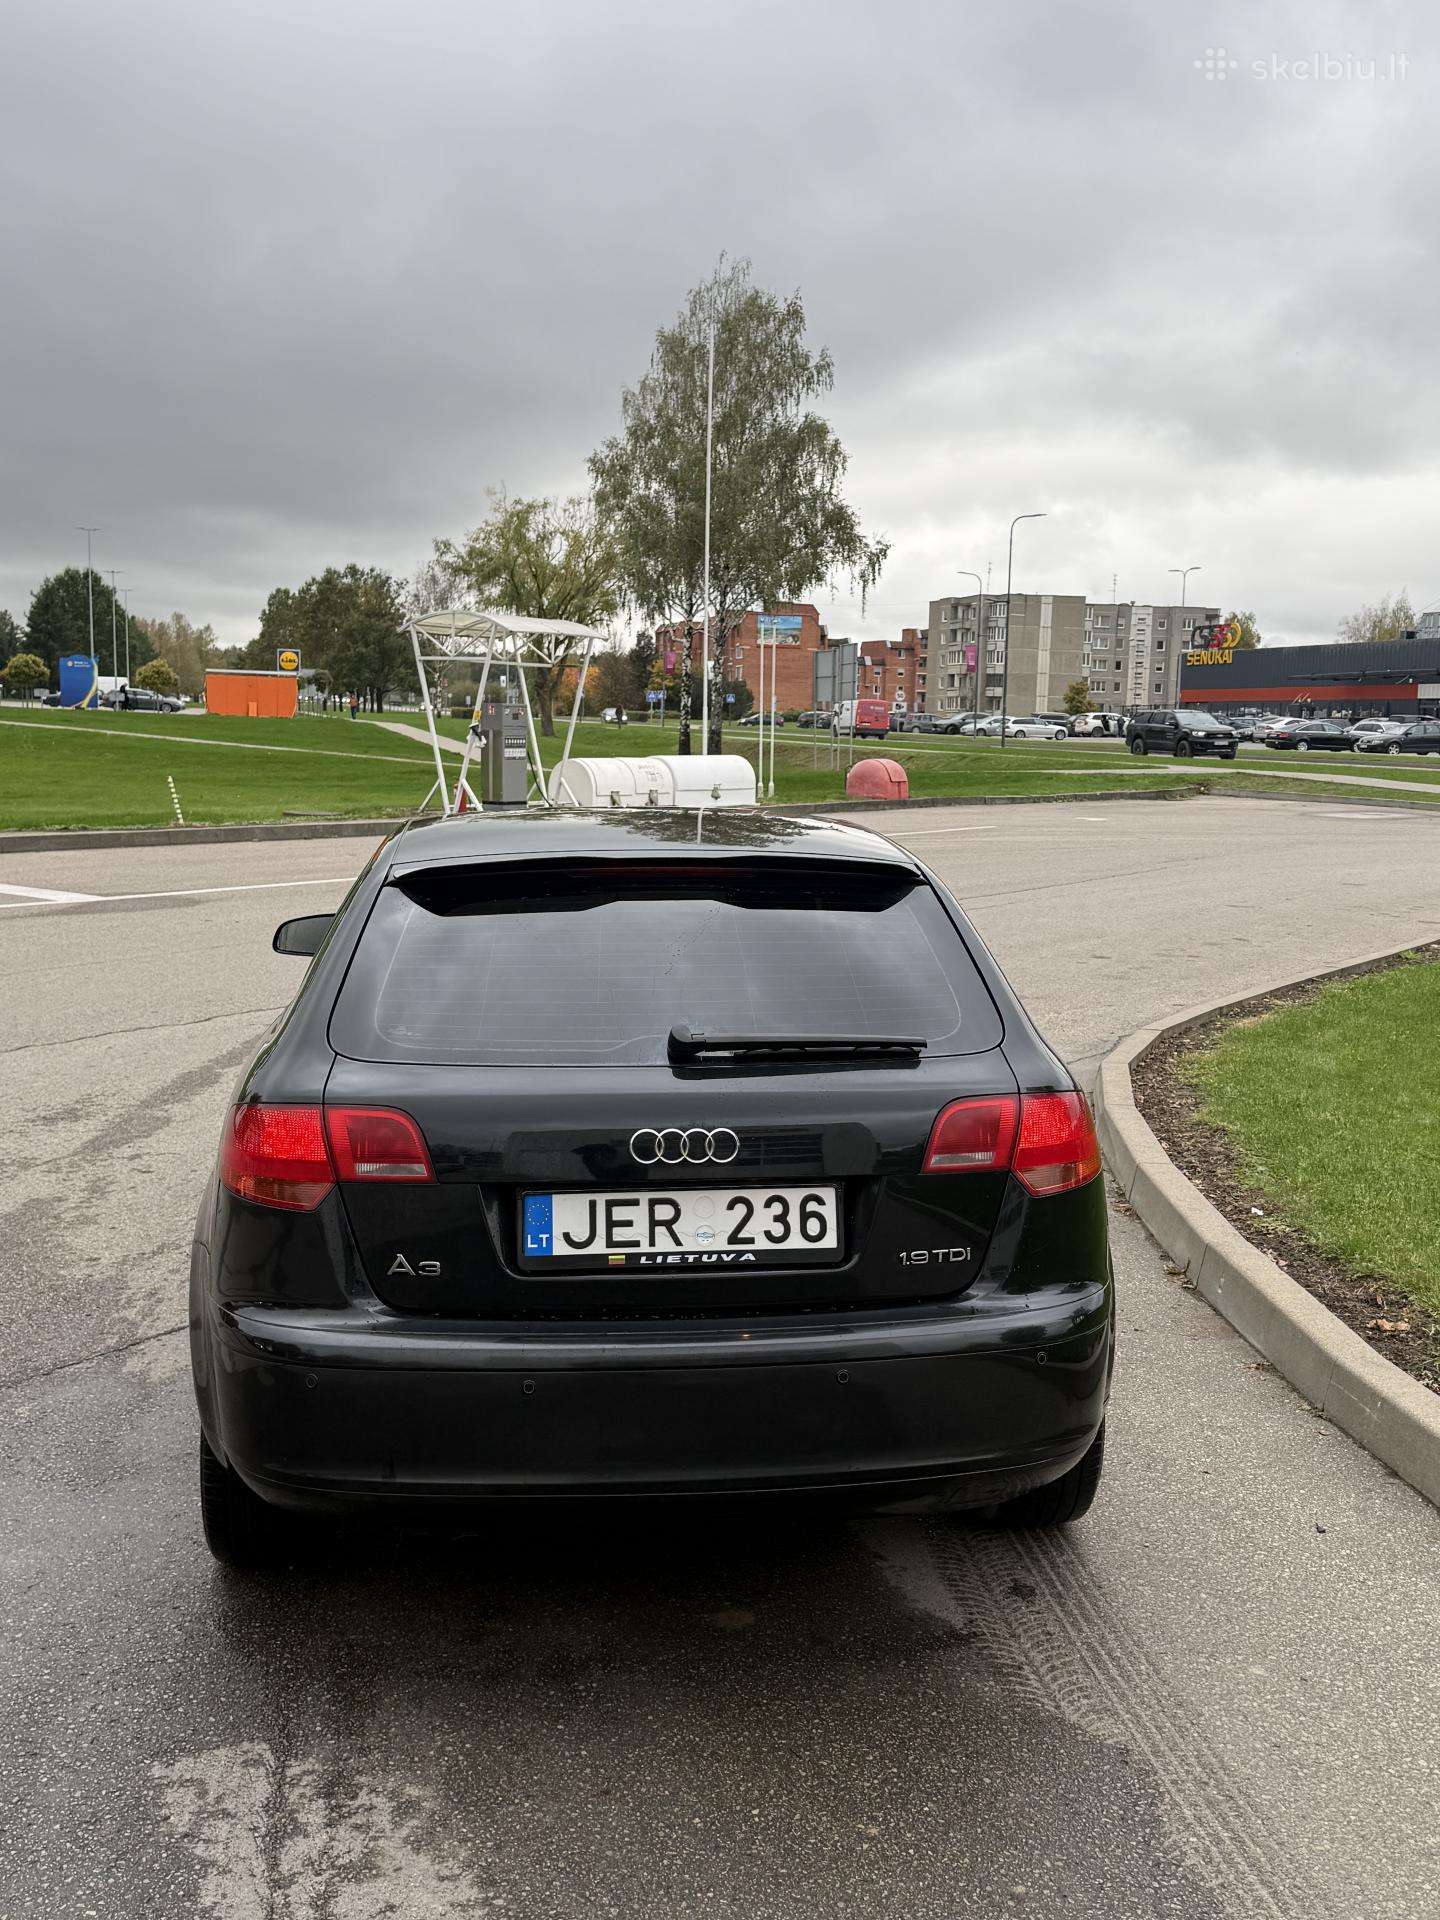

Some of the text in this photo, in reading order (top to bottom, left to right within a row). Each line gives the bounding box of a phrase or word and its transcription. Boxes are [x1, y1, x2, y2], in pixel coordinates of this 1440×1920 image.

[1187, 649, 1233, 666] SENUKAI
[562, 1193, 828, 1250] JER 236
[527, 1233, 550, 1248] LT
[387, 1253, 441, 1276] A3
[639, 1252, 756, 1264] LIETUVA
